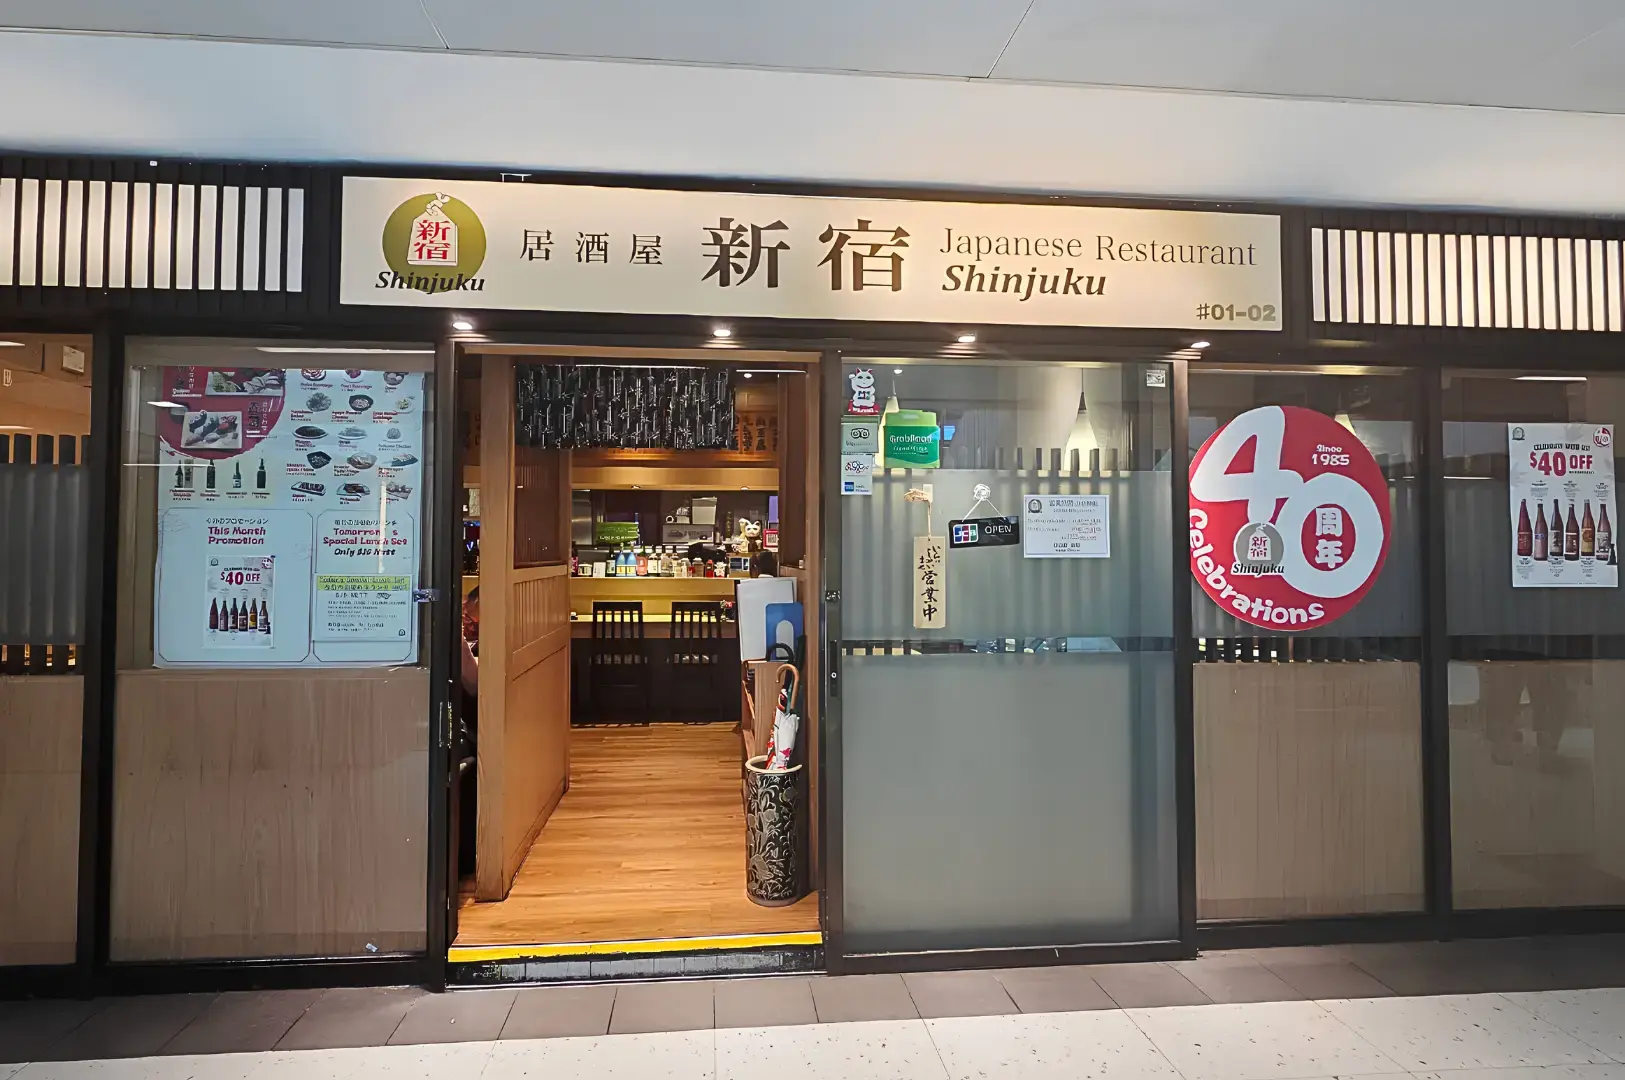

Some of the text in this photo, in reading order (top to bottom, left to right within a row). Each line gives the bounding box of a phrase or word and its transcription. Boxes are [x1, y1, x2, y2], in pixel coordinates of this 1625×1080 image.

[414, 220, 451, 260] 新宿
[939, 227, 1258, 265] Japanese Restaurant
[520, 217, 910, 291] 居酒屋 新宿
[375, 271, 485, 294] Shinjuku
[942, 264, 1106, 301] Shinjuku
[1196, 303, 1276, 322] #01-02
[1311, 453, 1350, 466] 1985
[1529, 451, 1593, 477] $40 OFF
[1190, 405, 1384, 598] 40
[207, 526, 266, 536] This Month
[208, 535, 264, 545] Promotion
[323, 536, 358, 547] Special
[955, 525, 1013, 537] JCB OPEN
[1315, 507, 1343, 569] 周年
[334, 547, 355, 557] Only
[1189, 508, 1325, 624] Celebrations
[1232, 563, 1285, 577] Shinjuku
[220, 571, 261, 586] $40 OFF
